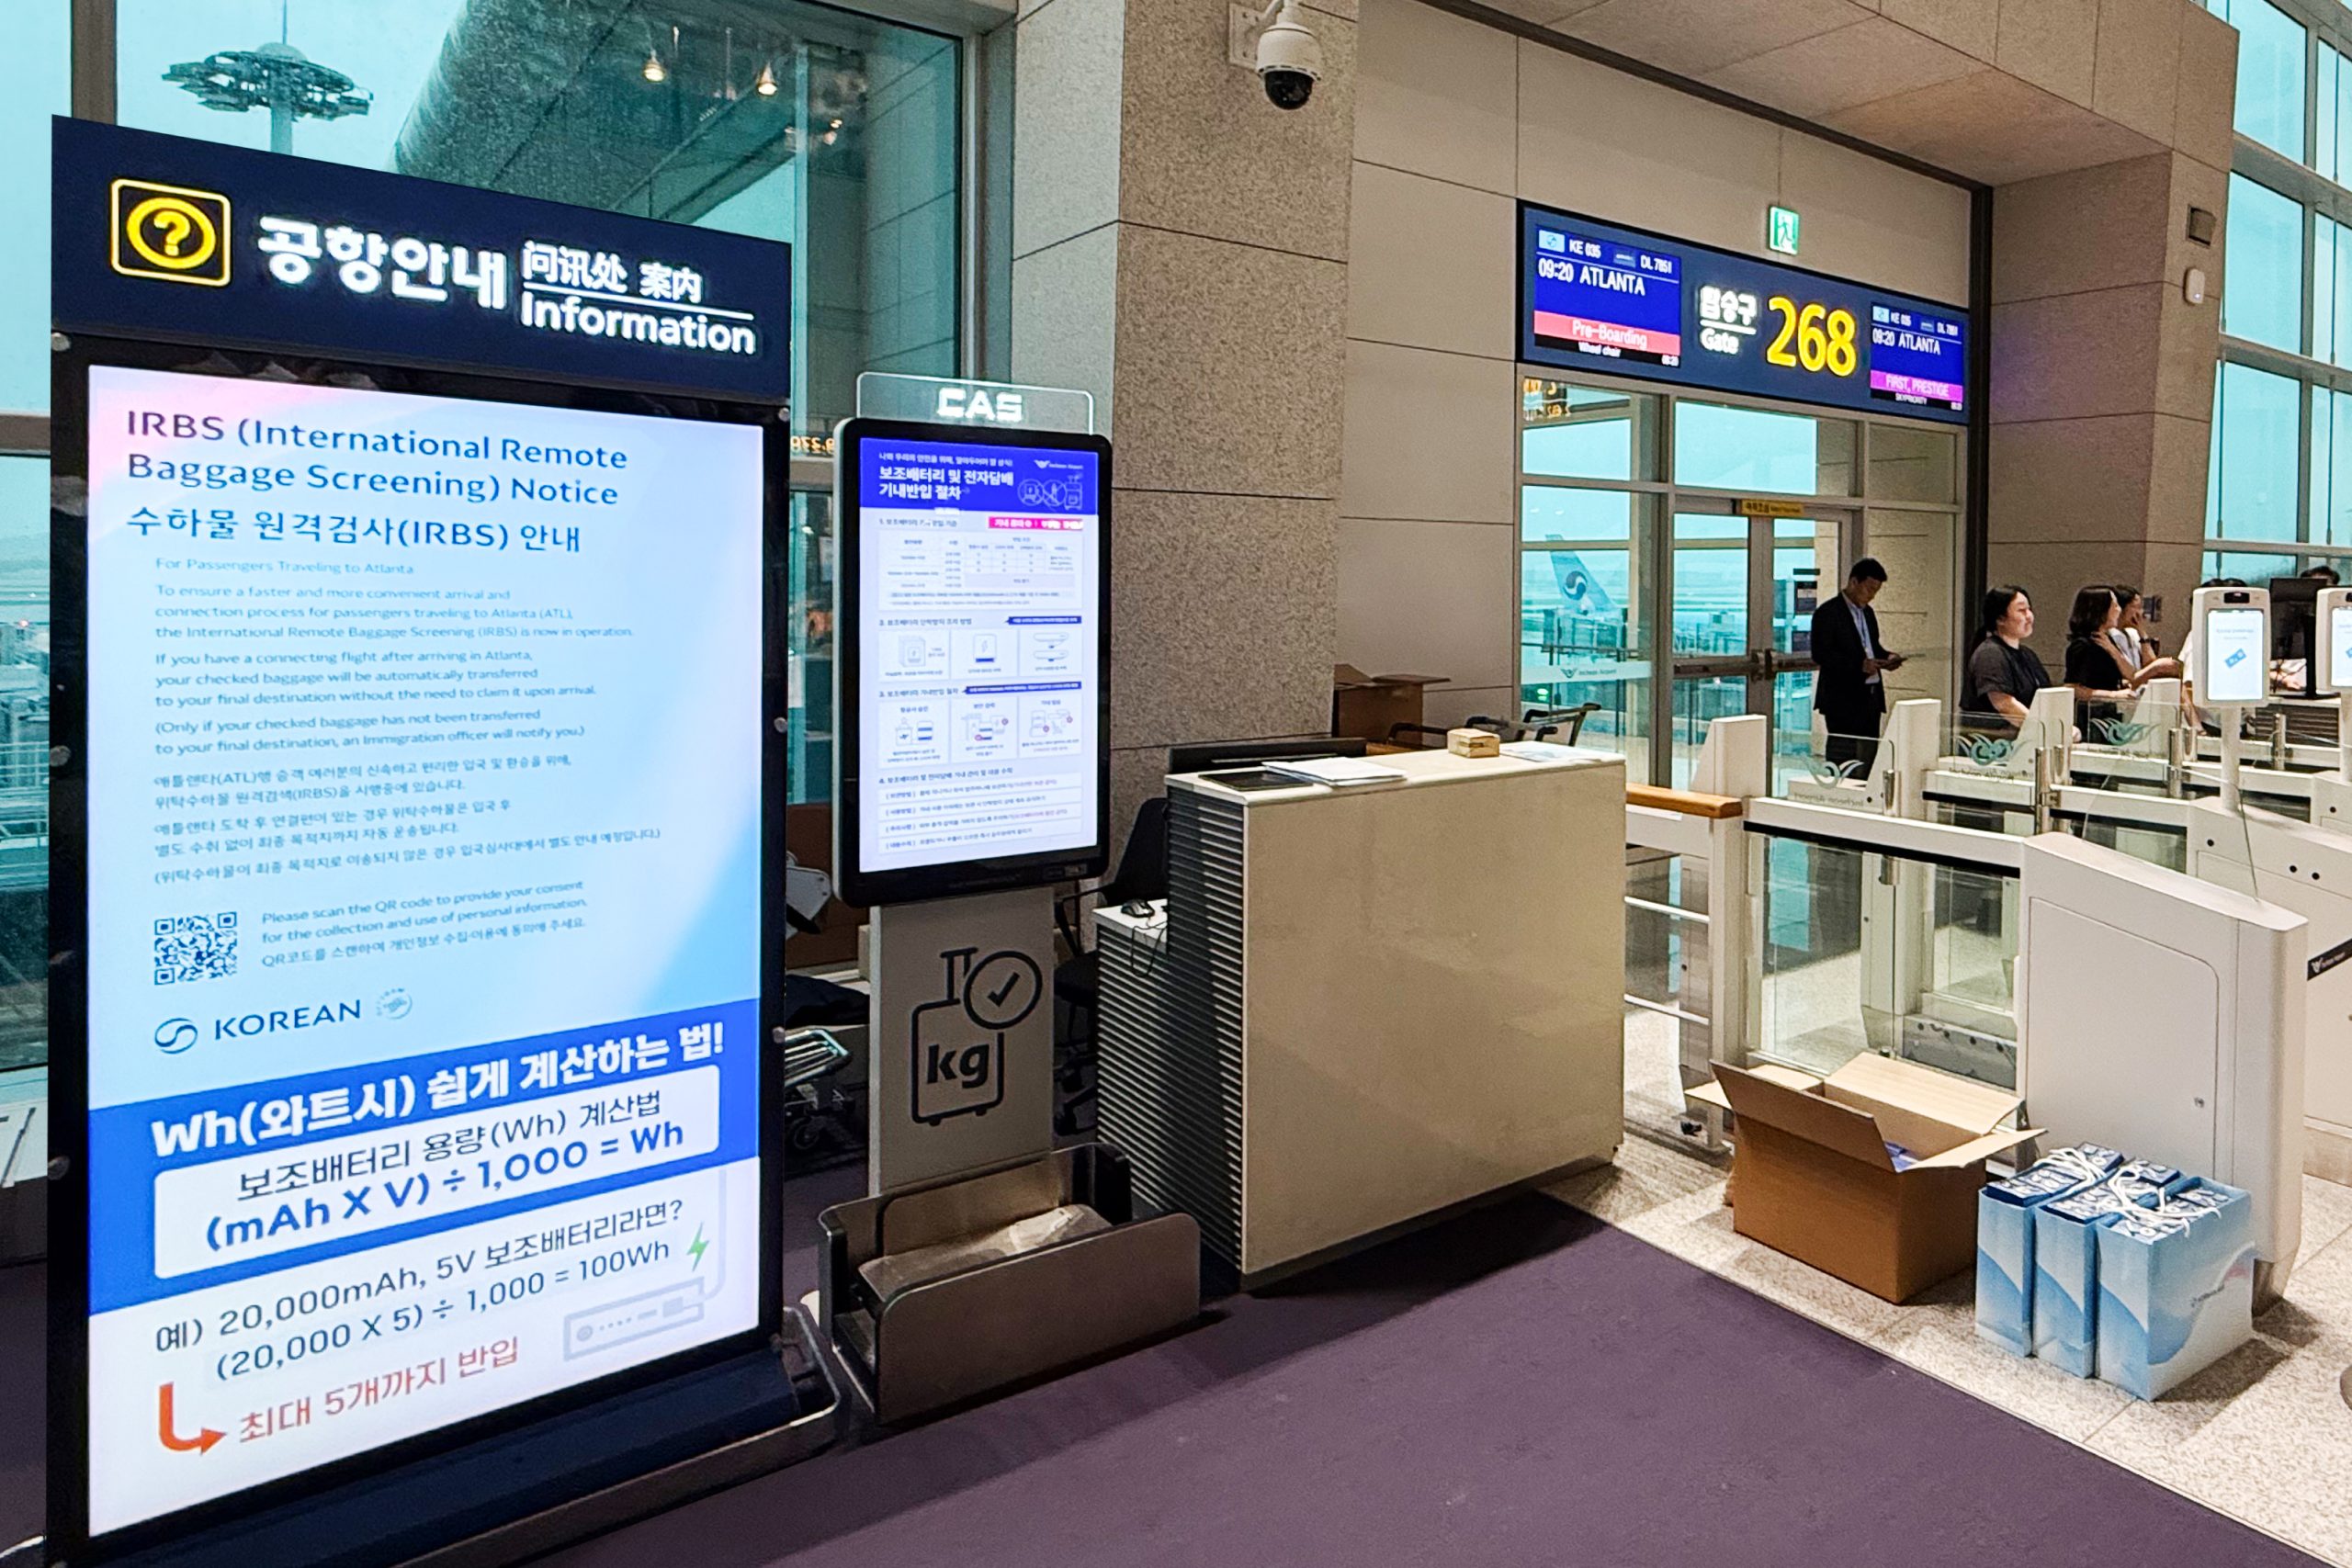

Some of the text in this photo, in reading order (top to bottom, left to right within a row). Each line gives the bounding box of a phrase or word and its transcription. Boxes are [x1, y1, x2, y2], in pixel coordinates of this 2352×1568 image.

[256, 214, 507, 310] 공항안내
[522, 240, 628, 295] 问讯处
[1569, 240, 1584, 255] KE
[1640, 255, 1653, 271] DL
[639, 261, 703, 303] 案内
[1538, 258, 1646, 296] 09:20 ATLANTA
[522, 289, 756, 355] Information
[1699, 285, 1758, 326] 탑승구
[1572, 320, 1647, 350] Pre-Boarding
[1699, 329, 1740, 355] Gate
[1767, 295, 1857, 377] 268
[1898, 333, 1941, 355] ATLANTA
[936, 388, 1023, 422] CAS
[127, 410, 628, 470] IRBS (International Remote
[127, 453, 618, 506] Baggage Screening) Notice
[879, 467, 1014, 486] 보조배터리 및 전자담배
[879, 483, 962, 501] 기내반입 절차
[126, 506, 581, 554] 수하물 원격검사(IRBS) 안내
[156, 558, 413, 575] For Passengers Traveling to Atlanta
[155, 626, 182, 637] the
[187, 626, 284, 637] International
[288, 626, 345, 637] Remote
[349, 626, 407, 639] Baggage
[410, 626, 475, 638] Screening
[478, 626, 517, 638] (IRBS)
[521, 626, 530, 637] is
[533, 628, 559, 637] now
[562, 626, 572, 637] in
[155, 669, 538, 688] your checked baggage will be automatically transferred
[156, 653, 166, 665] If
[171, 656, 200, 668] you
[205, 653, 240, 664] have
[256, 652, 337, 665] connecting
[341, 651, 377, 665] flight
[381, 651, 413, 662] after
[417, 650, 467, 662] arriving
[470, 650, 481, 660] in
[485, 650, 533, 661] Atlanta,
[155, 695, 174, 706] to
[177, 696, 212, 708] your
[218, 693, 250, 705] final
[254, 692, 336, 704] destination
[339, 690, 394, 701] without
[398, 690, 421, 700] the
[424, 688, 456, 699] need
[460, 689, 474, 698] to
[477, 687, 509, 697] claim
[513, 687, 521, 696] it
[525, 687, 555, 698] upon
[155, 709, 541, 735] (Only if your checked baggage has not been transferred
[155, 743, 174, 754] to
[176, 743, 213, 756] your
[218, 739, 250, 751] final
[254, 737, 339, 751] destination,
[342, 738, 359, 746] an
[363, 732, 445, 746] Immigration
[447, 730, 489, 741] officer
[492, 728, 514, 739] will
[516, 727, 551, 739] notify
[262, 881, 583, 924] Please scan the QR code to provide your consent
[262, 932, 283, 943] for
[288, 930, 312, 941] the
[316, 921, 384, 938] collection
[387, 917, 412, 929] and
[414, 915, 437, 926] use
[441, 912, 454, 924] of
[458, 906, 512, 922] personal
[214, 999, 362, 1040] KOREAN
[926, 1043, 990, 1089] kg
[152, 1021, 724, 1157] Wh(와트시) 쉽게 계산하는 법!
[237, 1090, 662, 1202] 보조배터리 용량(Wh) 계산법
[207, 1186, 330, 1252] (mAh
[384, 1172, 430, 1208] V)
[442, 1168, 466, 1192] ÷
[477, 1143, 588, 1190] 1,000
[600, 1137, 620, 1156] =
[630, 1121, 683, 1154] Wh
[155, 1198, 683, 1354] 예) 20,000mAh, 5V 보조배터리라면?
[216, 1323, 351, 1382] (20,000
[392, 1302, 424, 1332] 5)
[432, 1299, 454, 1320] ÷
[467, 1271, 545, 1314] 1,000
[555, 1268, 570, 1282] =
[579, 1239, 670, 1281] 100Wh
[239, 1337, 518, 1445] 최대 5개까지 반입
